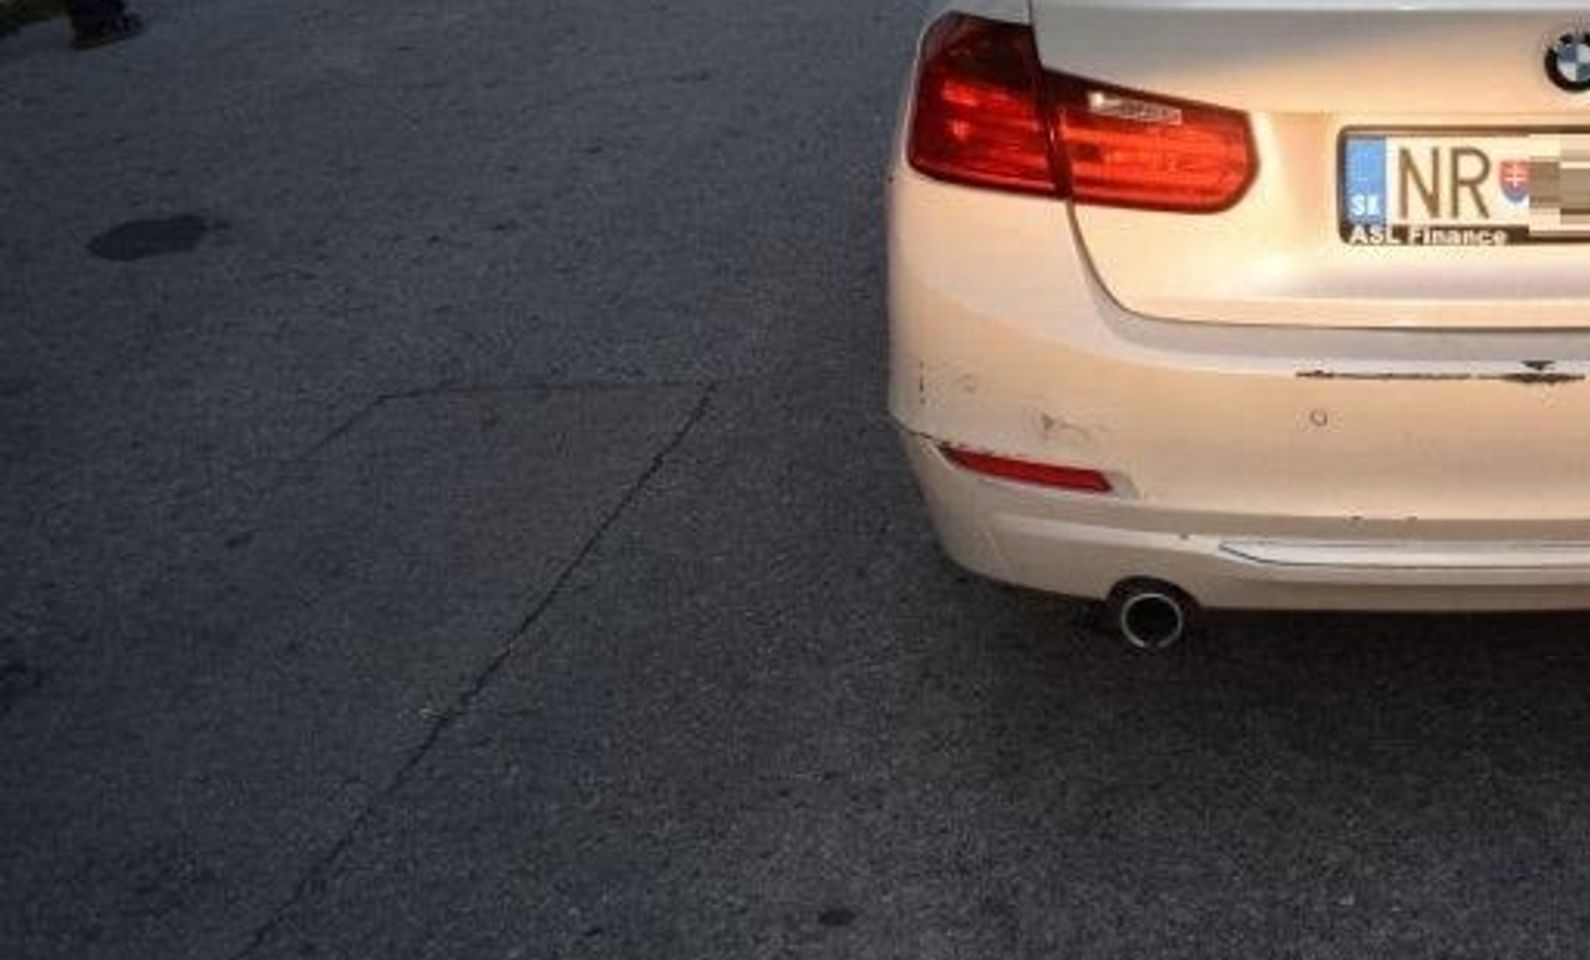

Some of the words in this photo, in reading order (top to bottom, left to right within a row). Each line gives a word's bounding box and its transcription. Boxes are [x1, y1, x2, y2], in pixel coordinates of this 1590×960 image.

[1399, 147, 1491, 219] NR
[1350, 225, 1401, 245] ASL
[1407, 226, 1508, 245] Finance
